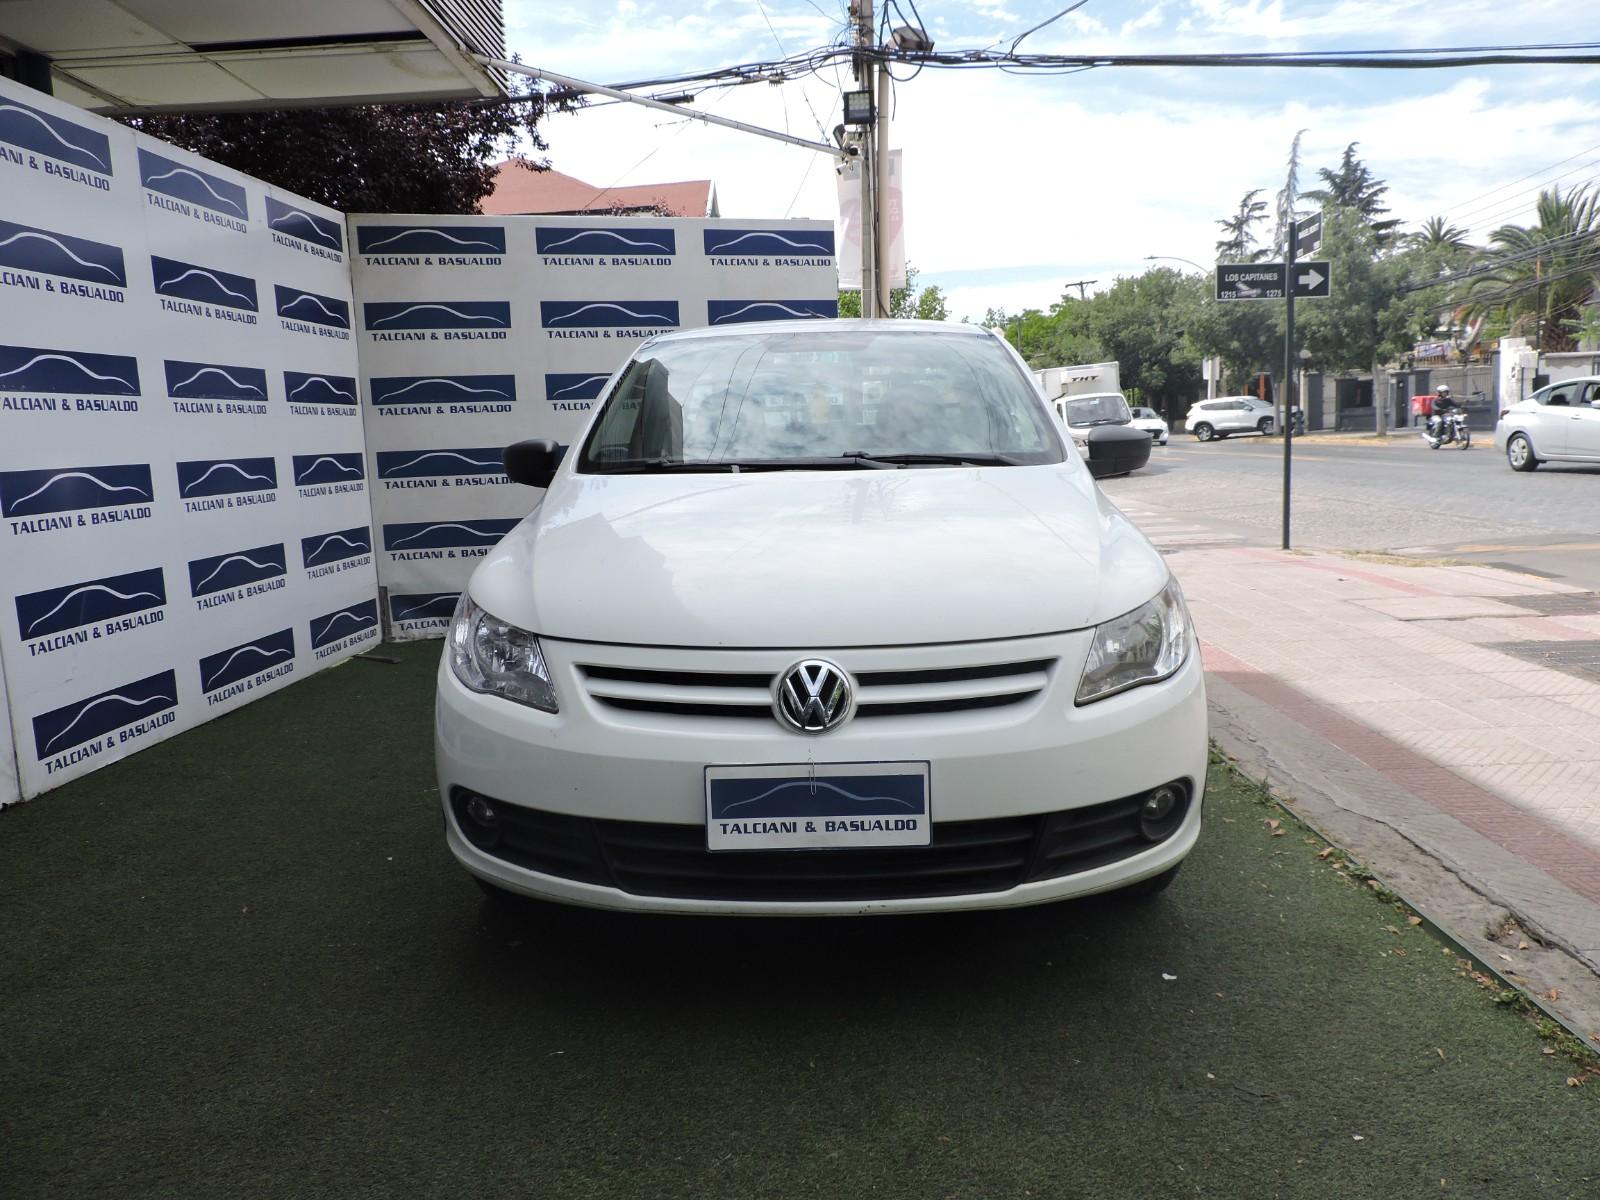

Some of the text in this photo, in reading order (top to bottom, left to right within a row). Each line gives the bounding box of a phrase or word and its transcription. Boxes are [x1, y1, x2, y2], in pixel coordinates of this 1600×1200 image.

[29, 156, 39, 170] &
[44, 161, 109, 191] BASUALDO
[147, 193, 247, 233] TALCIANI & BASUALDO
[272, 233, 301, 251] TALCIANI
[311, 246, 342, 263] BASUALDO
[364, 257, 419, 265] TALCIANI
[710, 258, 758, 266] TALCIANI
[1225, 272, 1278, 282] LOS CAPITANES
[0, 272, 124, 303] CIANI & BASUALDO
[160, 299, 256, 324] TALCIANI & BASUALDO
[281, 320, 311, 333] TALCIANI
[319, 327, 349, 340] BASUALDO
[371, 333, 425, 341] TALCIANI
[444, 332, 506, 340] BASUALDO
[547, 330, 598, 338] TALCIANI
[3, 397, 138, 411] ALCIANI & BASUALDO
[173, 402, 266, 414] TALCIANI & BASUALDO
[290, 406, 318, 415] TALCIANI
[327, 408, 356, 416] BASUALDO
[378, 405, 511, 416] TALCIANI & BASUALDO
[552, 402, 594, 411] TALCIA
[298, 487, 326, 497] TALCIANI
[335, 483, 363, 493] BASUALDO
[384, 480, 437, 489] TALCIANI
[185, 493, 276, 512] TALCIANI & BASUALDO
[11, 507, 151, 535] TALCIANI & BASUALDO
[390, 551, 442, 560] TALCIANI
[307, 565, 334, 579] TALCIANI
[342, 556, 370, 570] BASUALDO
[197, 579, 285, 610] TALCIANI & BASUALDO
[399, 618, 450, 631] TALCIANI
[28, 610, 163, 656] TALCIANI & BASUALDO
[315, 643, 341, 660] TALCIANI
[350, 628, 377, 646] BASUALDO
[207, 663, 293, 706] TALCIANI & BASUALDO
[45, 712, 175, 774] TALCIANI & BASUALDO
[720, 820, 917, 834] TALCIANI & BASUALDO
